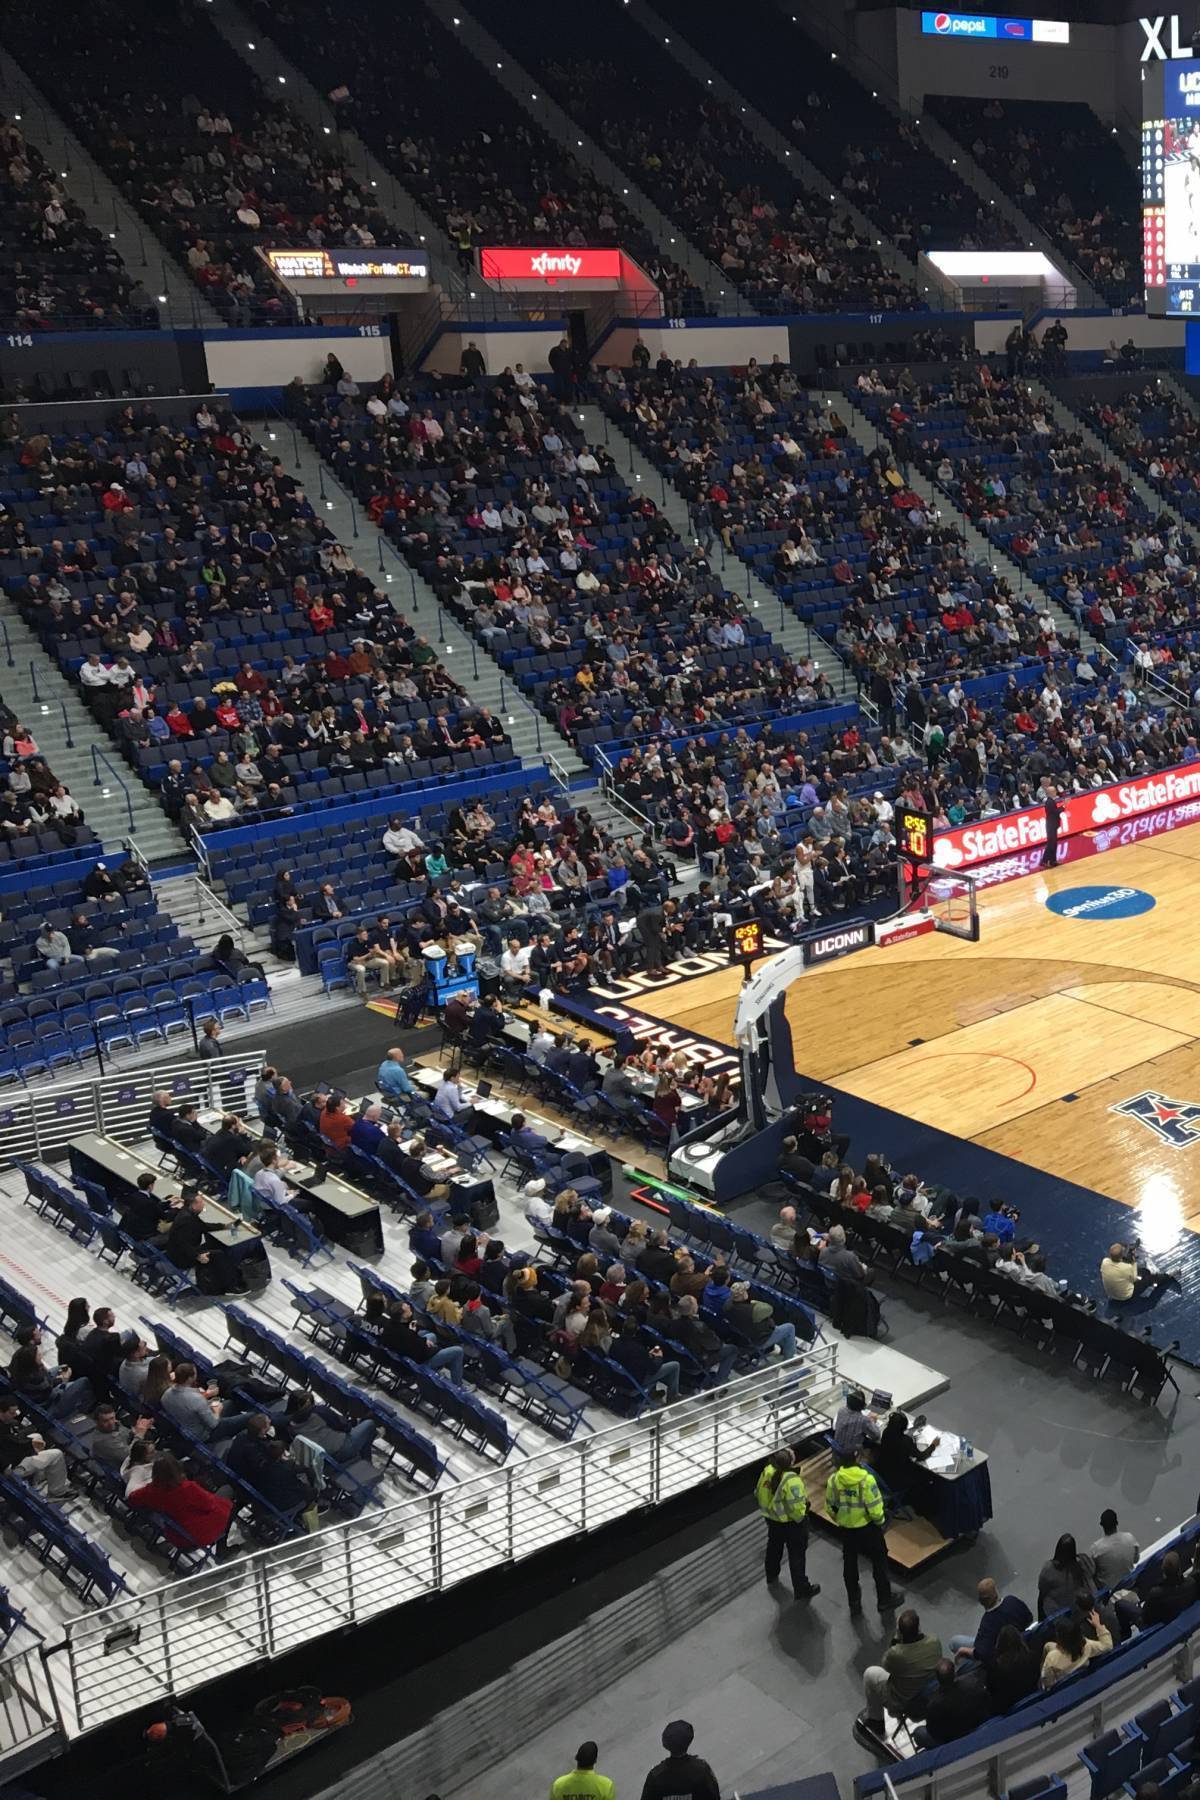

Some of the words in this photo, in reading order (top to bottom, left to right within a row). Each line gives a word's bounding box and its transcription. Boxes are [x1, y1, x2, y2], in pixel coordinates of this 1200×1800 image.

[953, 19, 986, 34] pepsi
[1139, 15, 1193, 61] XL
[276, 257, 322, 269] WATCH
[531, 253, 581, 275] xfinity
[669, 318, 686, 328] 116
[869, 314, 883, 324] 117
[358, 325, 380, 336] 115
[8, 335, 32, 347] 114
[904, 815, 926, 833] 12:55
[910, 832, 925, 855] 10
[1063, 889, 1136, 918] genius3D
[735, 924, 759, 939] 12:55
[814, 929, 864, 955] UCONN
